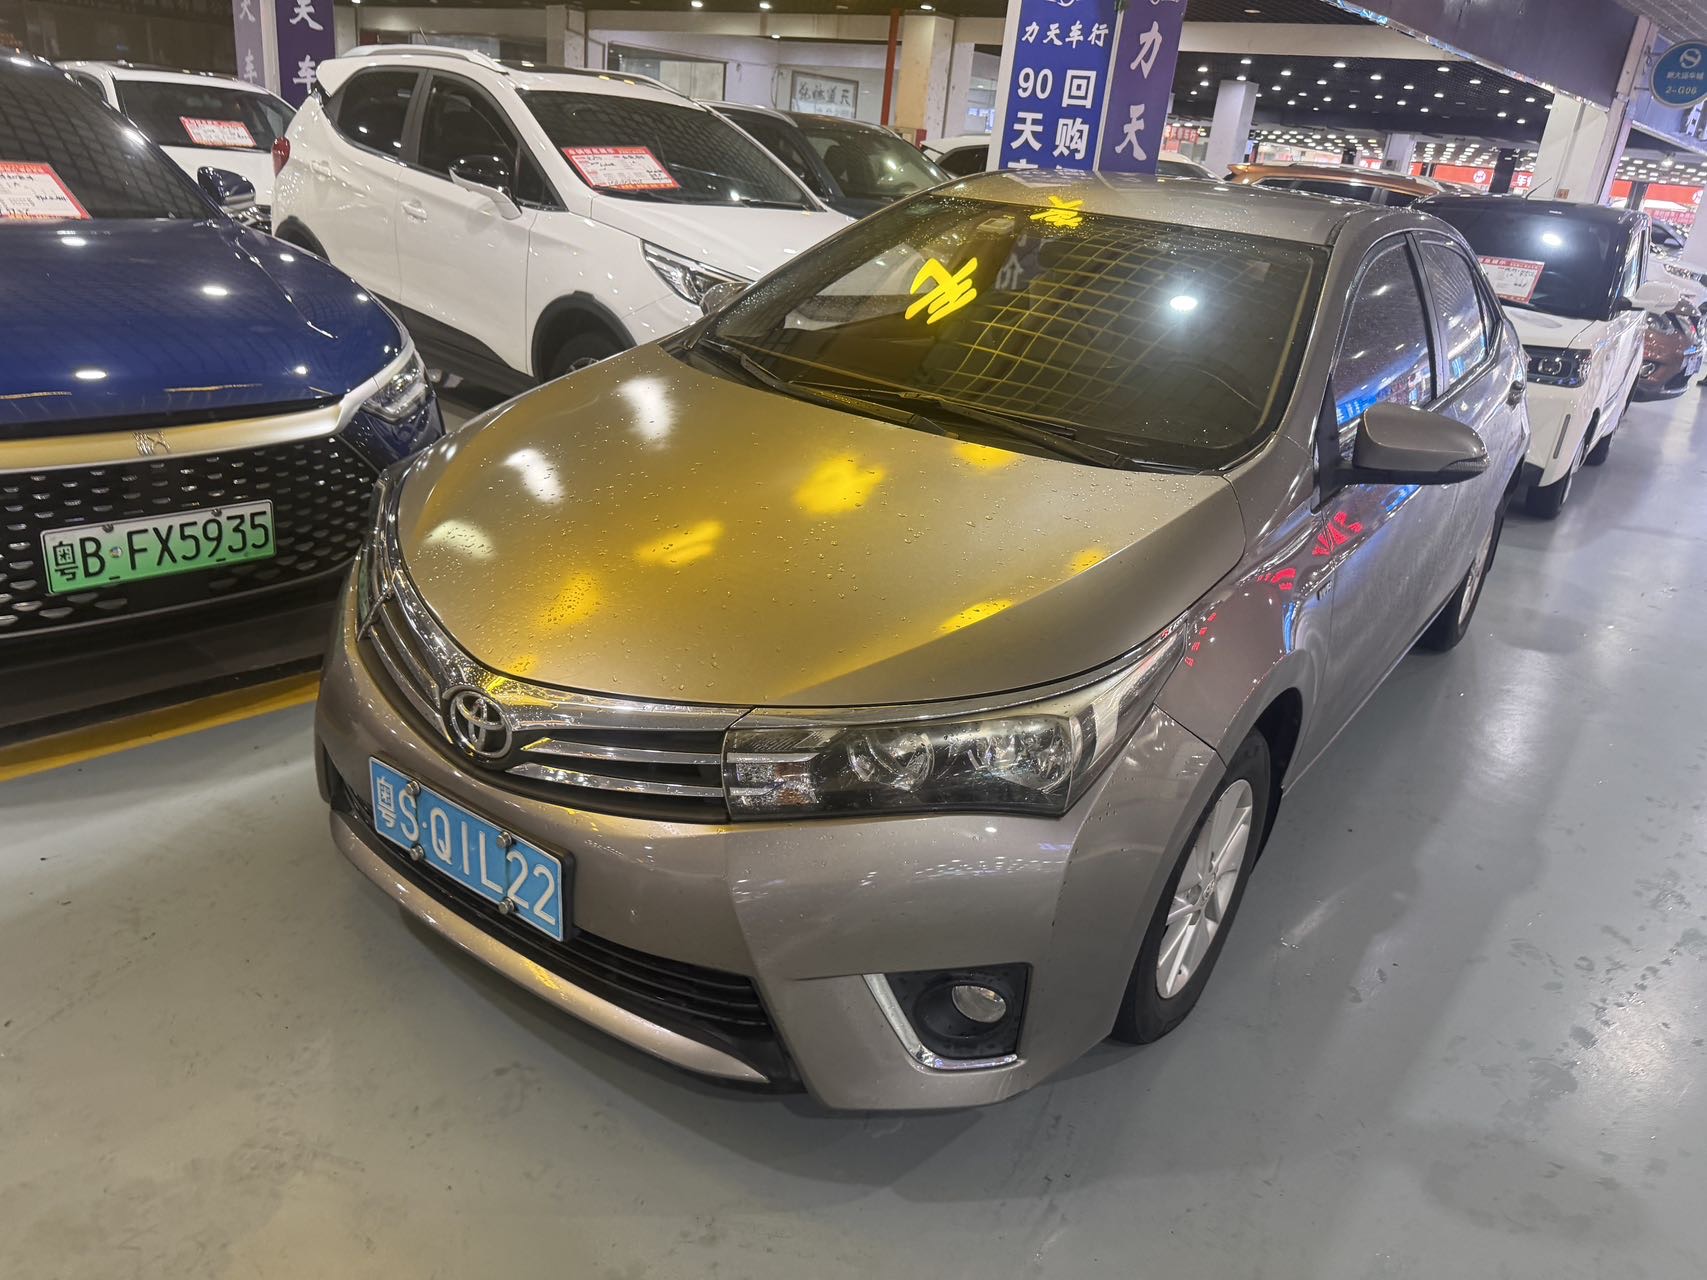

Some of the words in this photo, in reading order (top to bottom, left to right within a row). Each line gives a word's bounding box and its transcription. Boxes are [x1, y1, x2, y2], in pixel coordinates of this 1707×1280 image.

[1021, 20, 1109, 48] 力天车行
[1052, 70, 1097, 171] 回购
[1115, 21, 1163, 161] 力天
